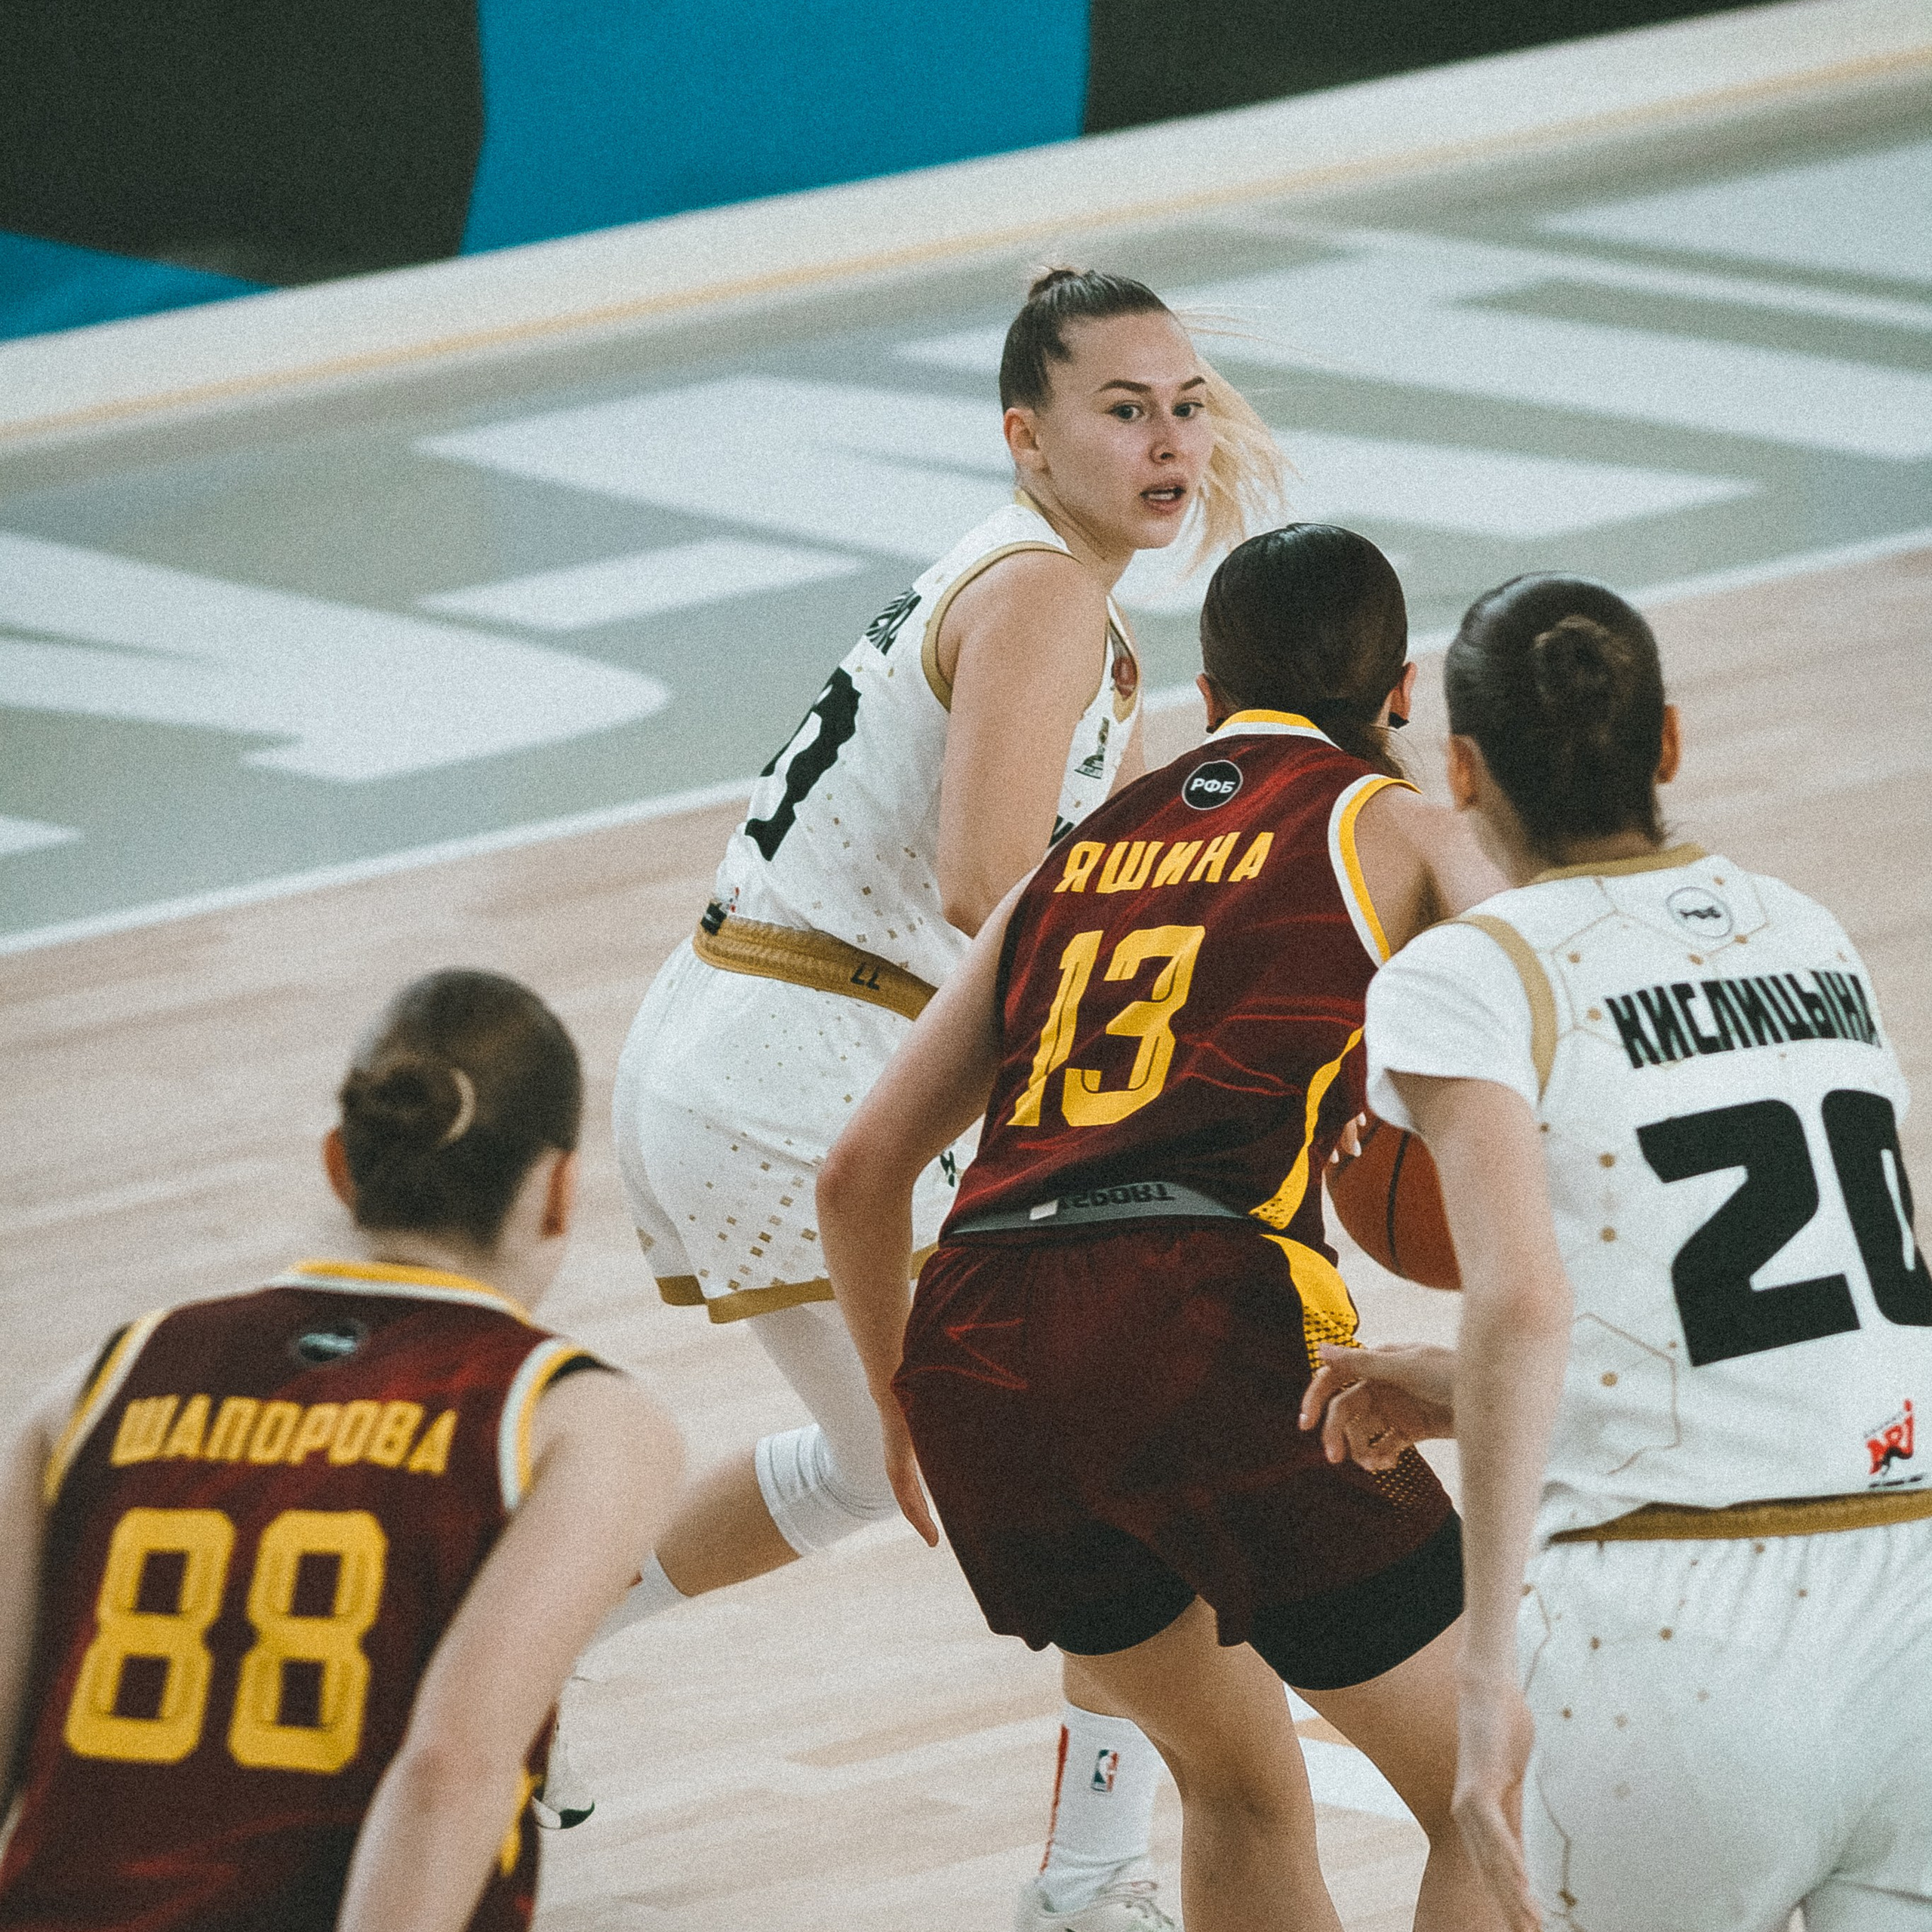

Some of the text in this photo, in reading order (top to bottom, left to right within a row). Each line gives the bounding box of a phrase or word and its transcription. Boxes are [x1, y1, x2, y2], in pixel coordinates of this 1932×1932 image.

[1190, 777, 1236, 793] РФБ
[1053, 831, 1275, 894] ЯШИНА
[1006, 924, 1206, 1128] 13
[1635, 1088, 1932, 1367] 20
[110, 1393, 458, 1476] ШАПОРОВА
[64, 1508, 389, 1774] 88
